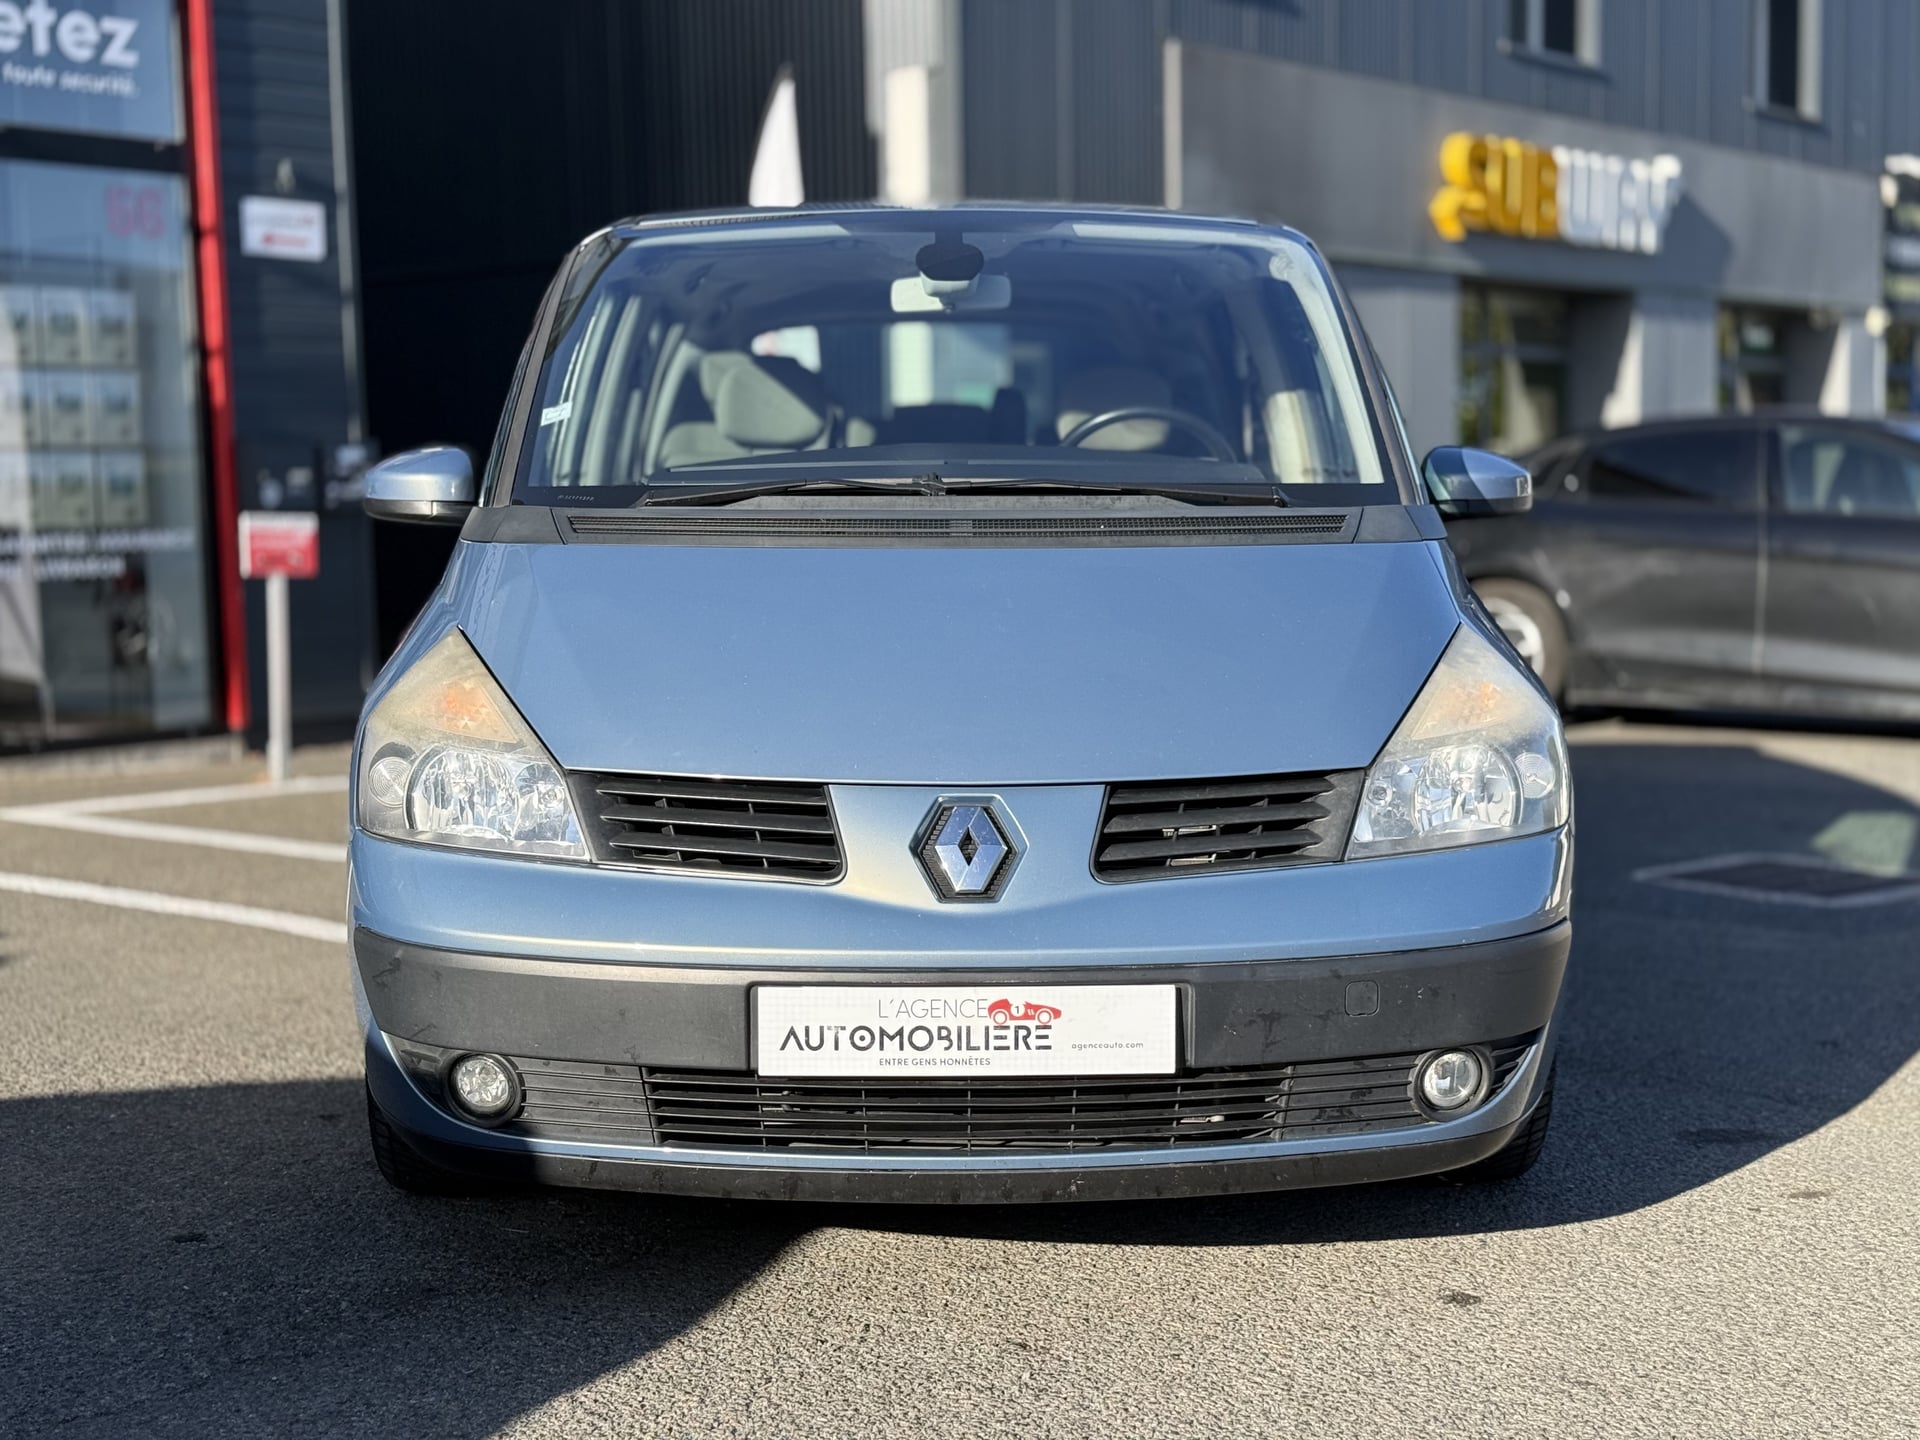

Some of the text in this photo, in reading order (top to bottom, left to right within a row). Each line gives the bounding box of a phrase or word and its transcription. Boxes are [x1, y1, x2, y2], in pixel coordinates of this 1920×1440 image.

[878, 999, 988, 1018] L'AGENCE
[779, 1025, 1052, 1051] AUTOMOBILIERE
[1071, 1041, 1144, 1051] agenceauto.com
[879, 1055, 991, 1066] ENTRE GENS HONNÊTES
